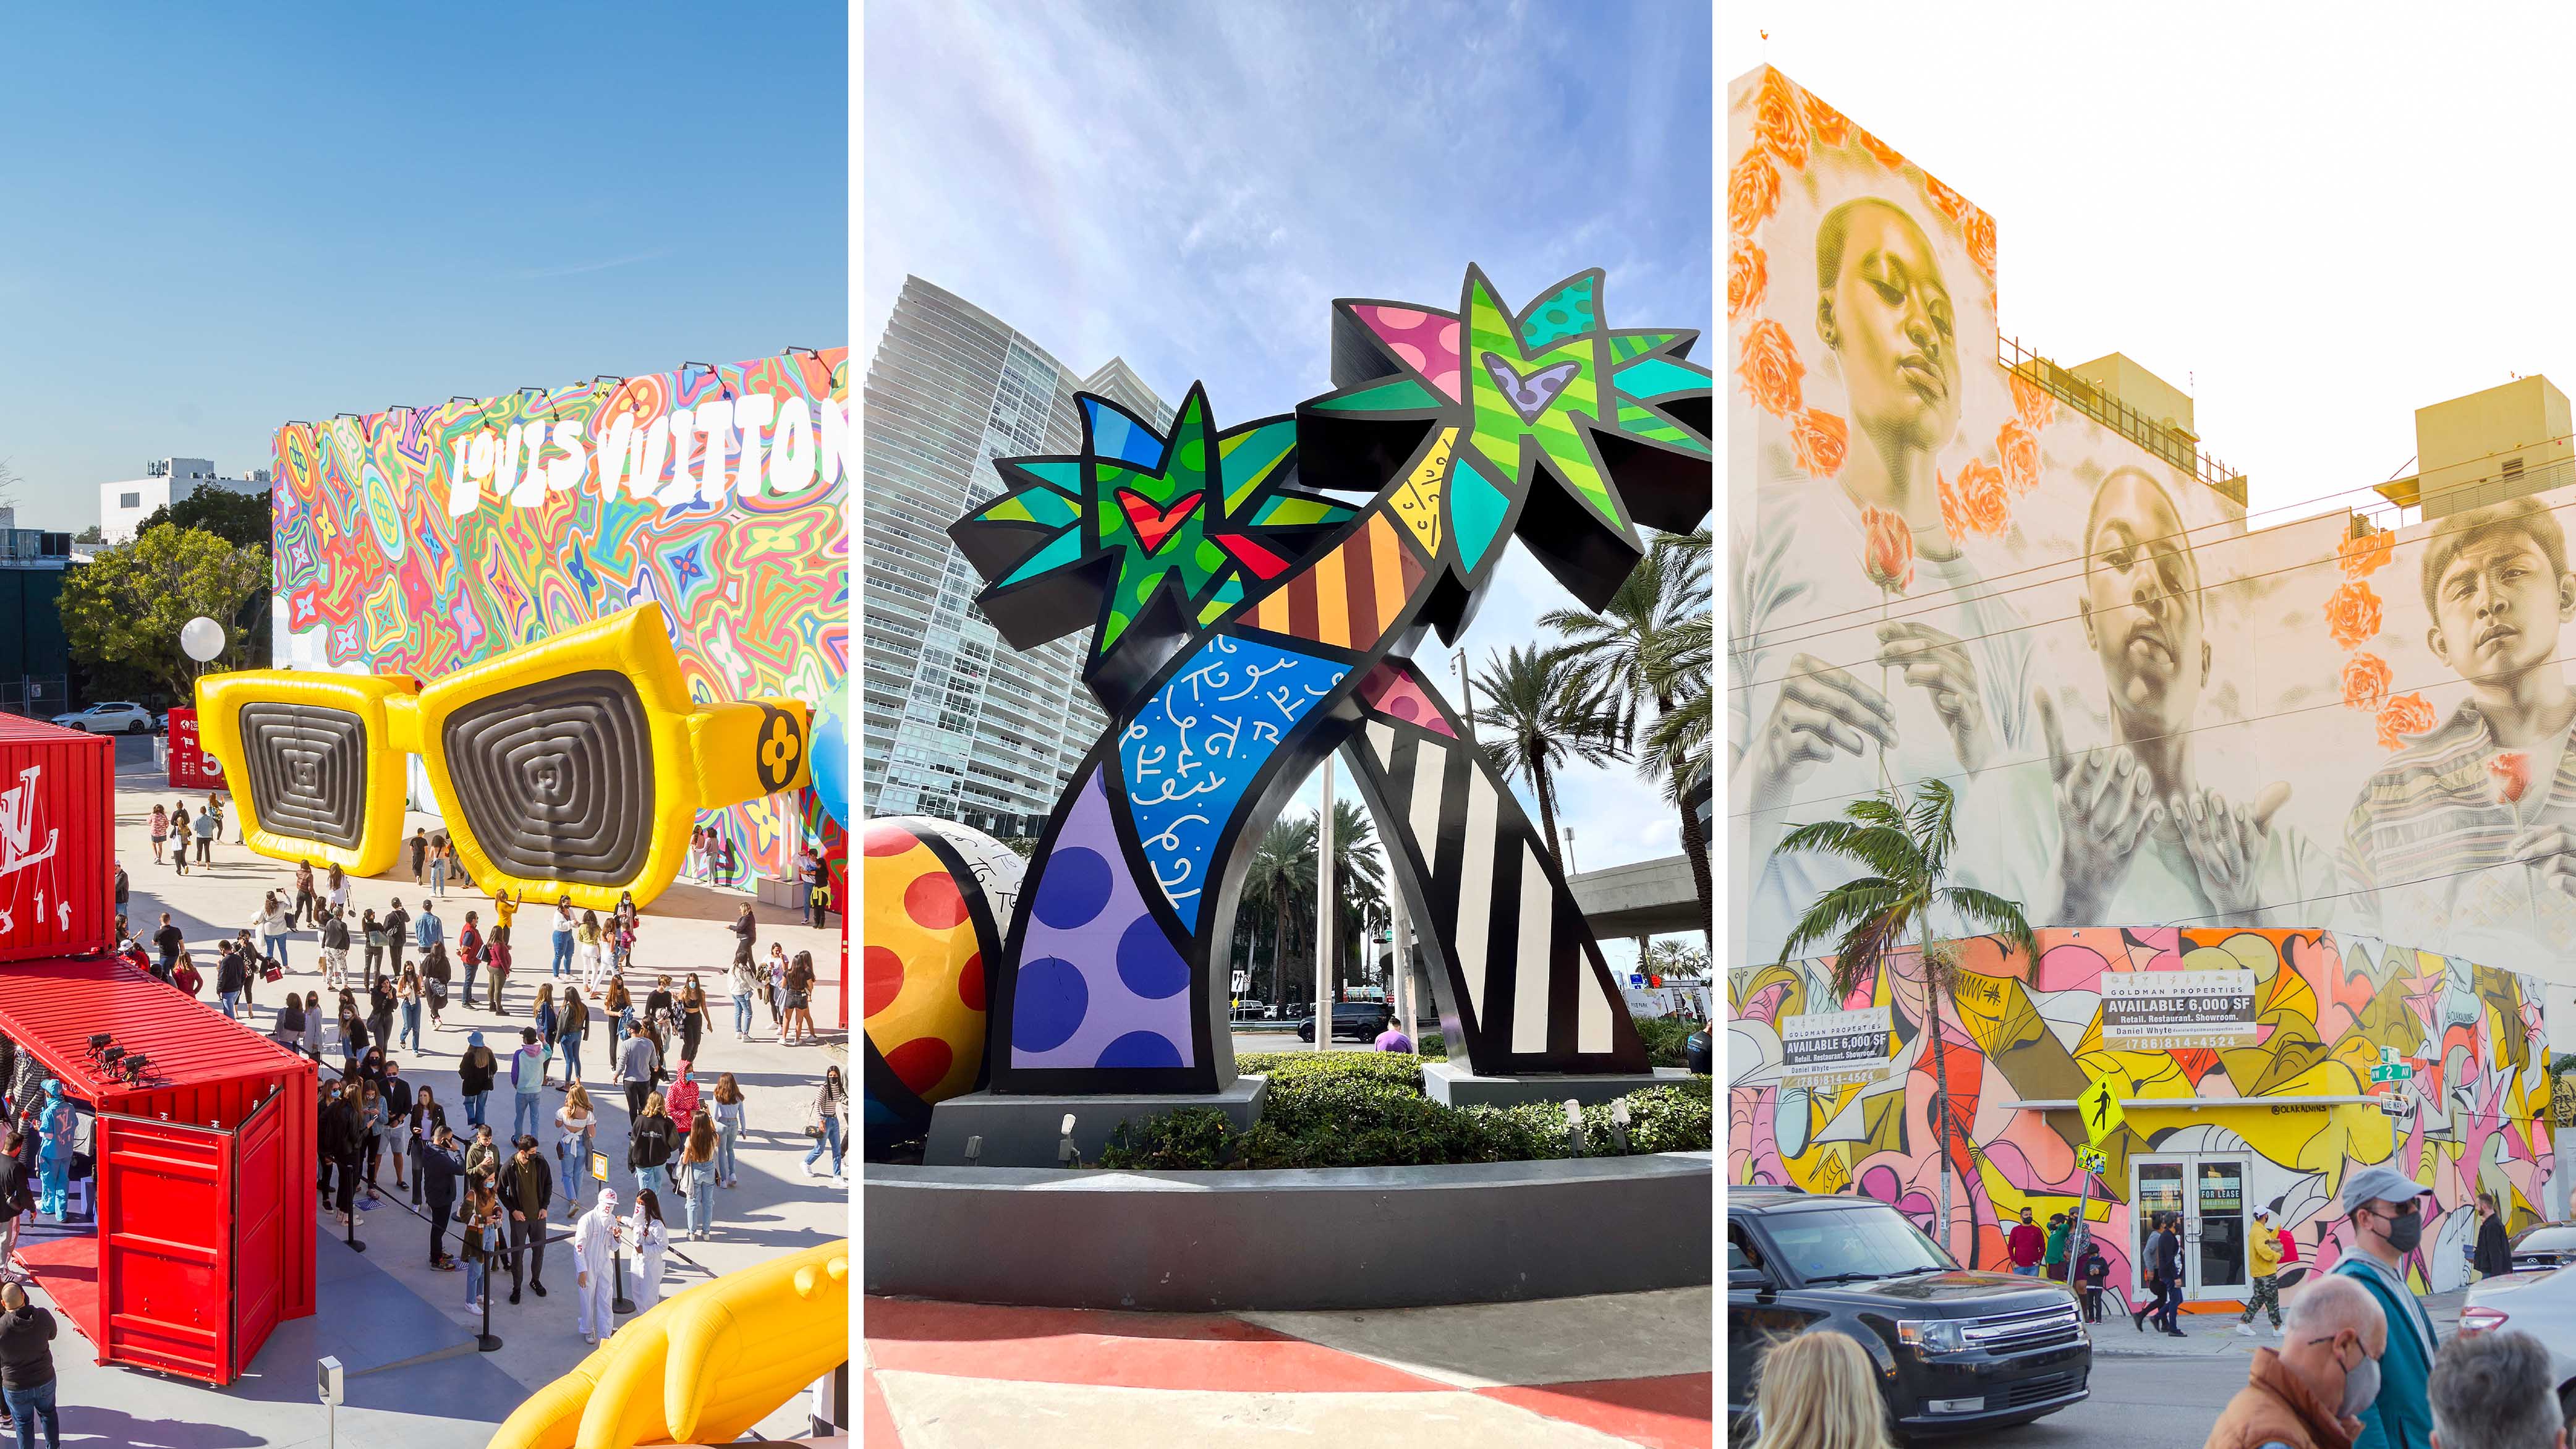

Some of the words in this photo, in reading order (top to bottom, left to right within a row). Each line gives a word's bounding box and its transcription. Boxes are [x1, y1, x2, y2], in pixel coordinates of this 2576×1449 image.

[448, 419, 587, 517] LOUIS
[2108, 999, 2185, 1013] AVAILABLE
[2189, 998, 2229, 1012] 6,000
[2234, 998, 2250, 1009] SF
[2149, 1014, 2193, 1022] Restaurant.
[2196, 1013, 2238, 1021] Showroom.
[1789, 1029, 1826, 1038] GOLDMAN
[1831, 1024, 1881, 1034] PROPERTIES
[2117, 1027, 2143, 1035] Daniel
[2146, 1026, 2172, 1035] Whyte
[1787, 1038, 1838, 1053] AVAILABLE
[1842, 1035, 1870, 1050] 6,000
[1873, 1034, 1886, 1045] SF
[2127, 1037, 2235, 1049] (786)814-4524
[1813, 1052, 1845, 1061] Restaurant.
[1845, 1050, 1877, 1058] Showroom.
[1792, 1065, 1809, 1074] Daniel
[1812, 1064, 1829, 1073] Whyte
[2372, 1070, 2379, 1079] NW
[2386, 1066, 2393, 1079] 2
[2401, 1068, 2409, 1077] AV
[1798, 1072, 1874, 1087] (786)814-4524
[2217, 1190, 2240, 1198] LEASE
